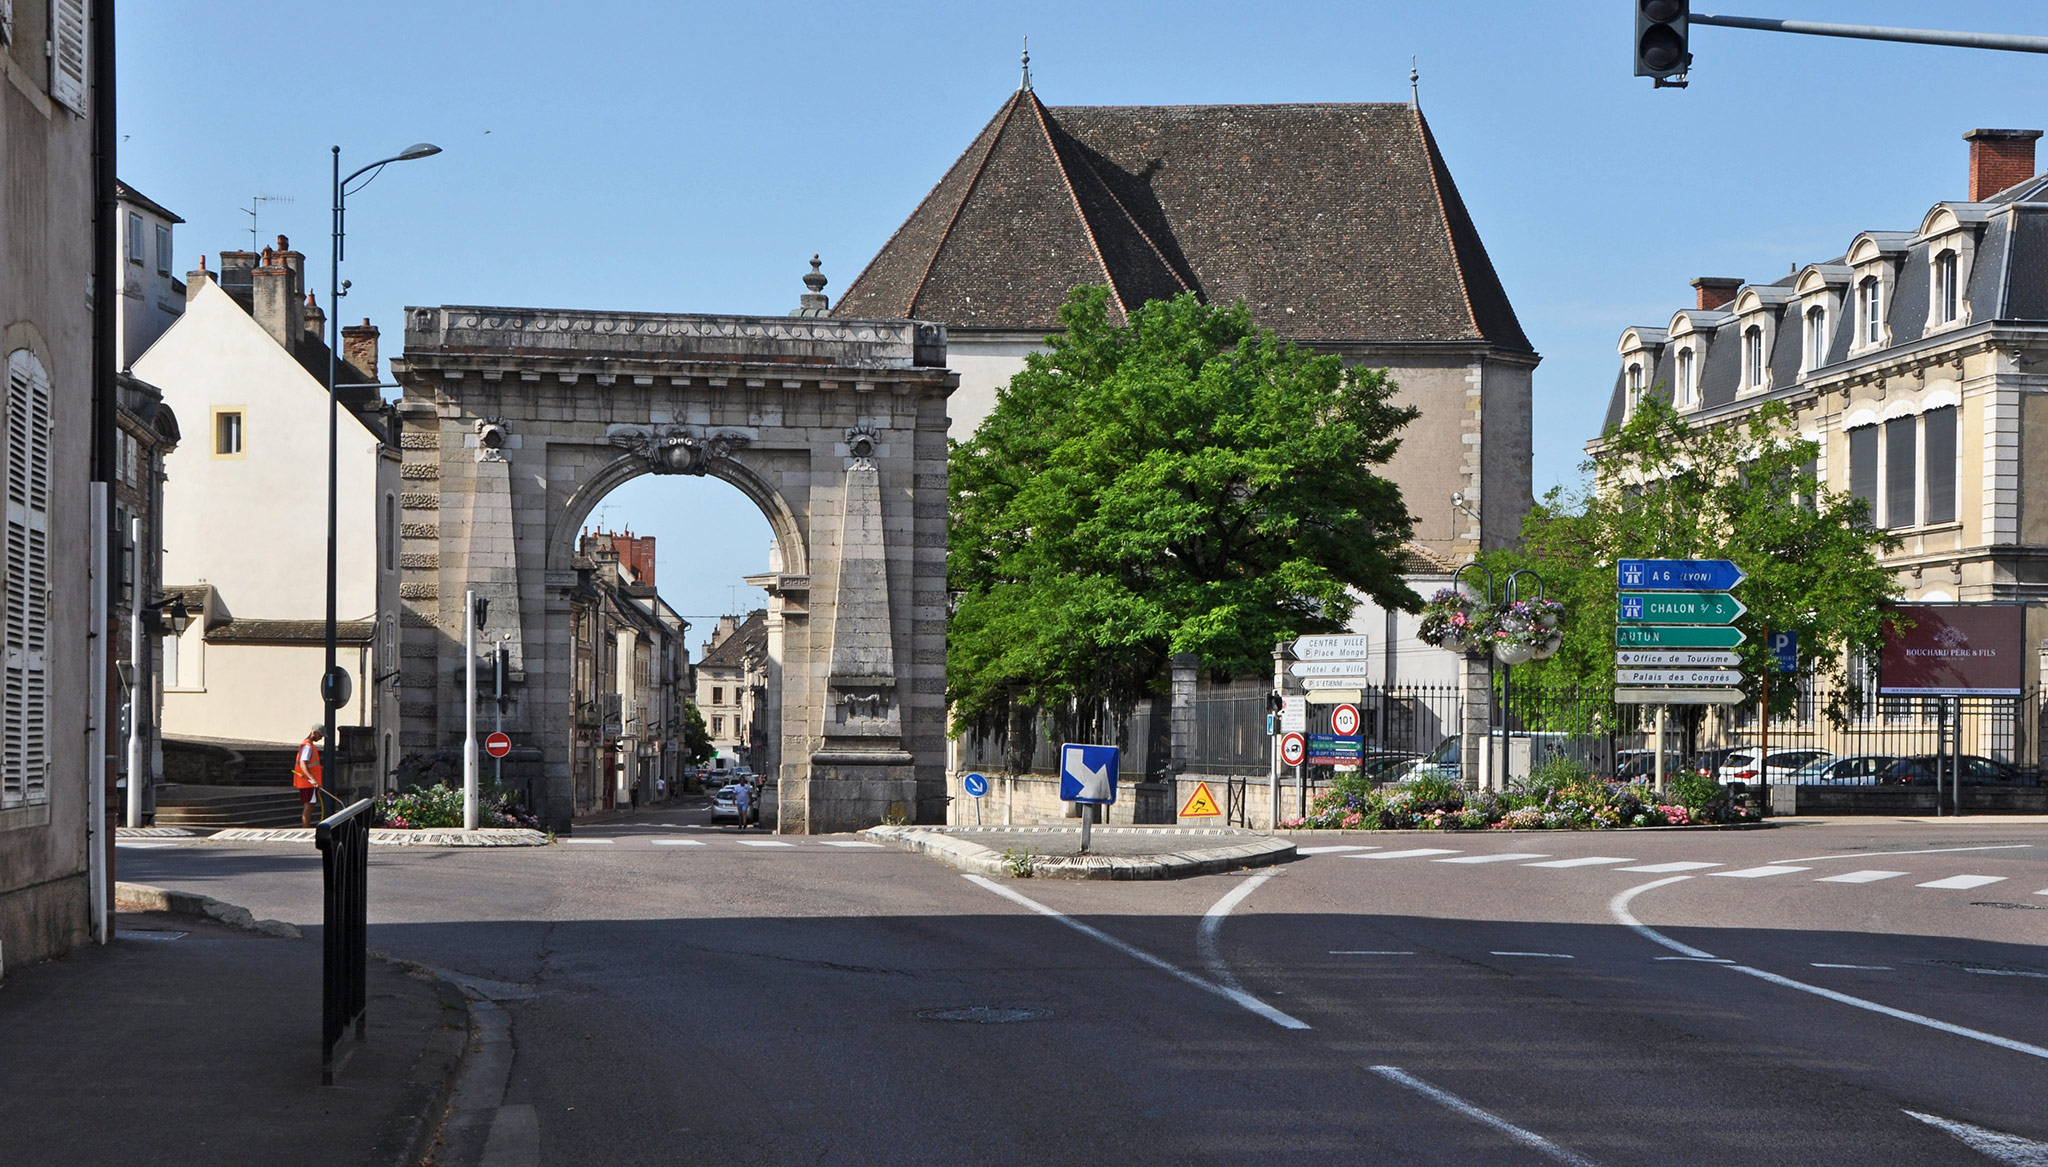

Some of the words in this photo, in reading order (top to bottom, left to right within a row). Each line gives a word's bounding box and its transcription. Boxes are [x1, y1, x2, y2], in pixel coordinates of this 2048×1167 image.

[1652, 571, 1659, 581] A
[1663, 571, 1671, 581] 6
[1680, 573, 1712, 582] (LYON)
[1650, 603, 1695, 614] CHALON
[1620, 631, 1660, 642] AUTUN
[1309, 639, 1338, 647] CENTRE
[1343, 638, 1364, 647] VILLE
[1776, 633, 1789, 653] P
[1340, 649, 1364, 657] Monge
[1906, 648, 1949, 657] BOUCHARD
[1950, 647, 1971, 657] PÈRE
[1978, 649, 1996, 657] FILS
[1633, 654, 1662, 663] Office
[1669, 654, 1680, 663] de
[1687, 654, 1729, 664] Tourisme
[1345, 665, 1364, 673] Ville
[1633, 672, 1662, 681] Palais
[1669, 672, 1685, 681] des
